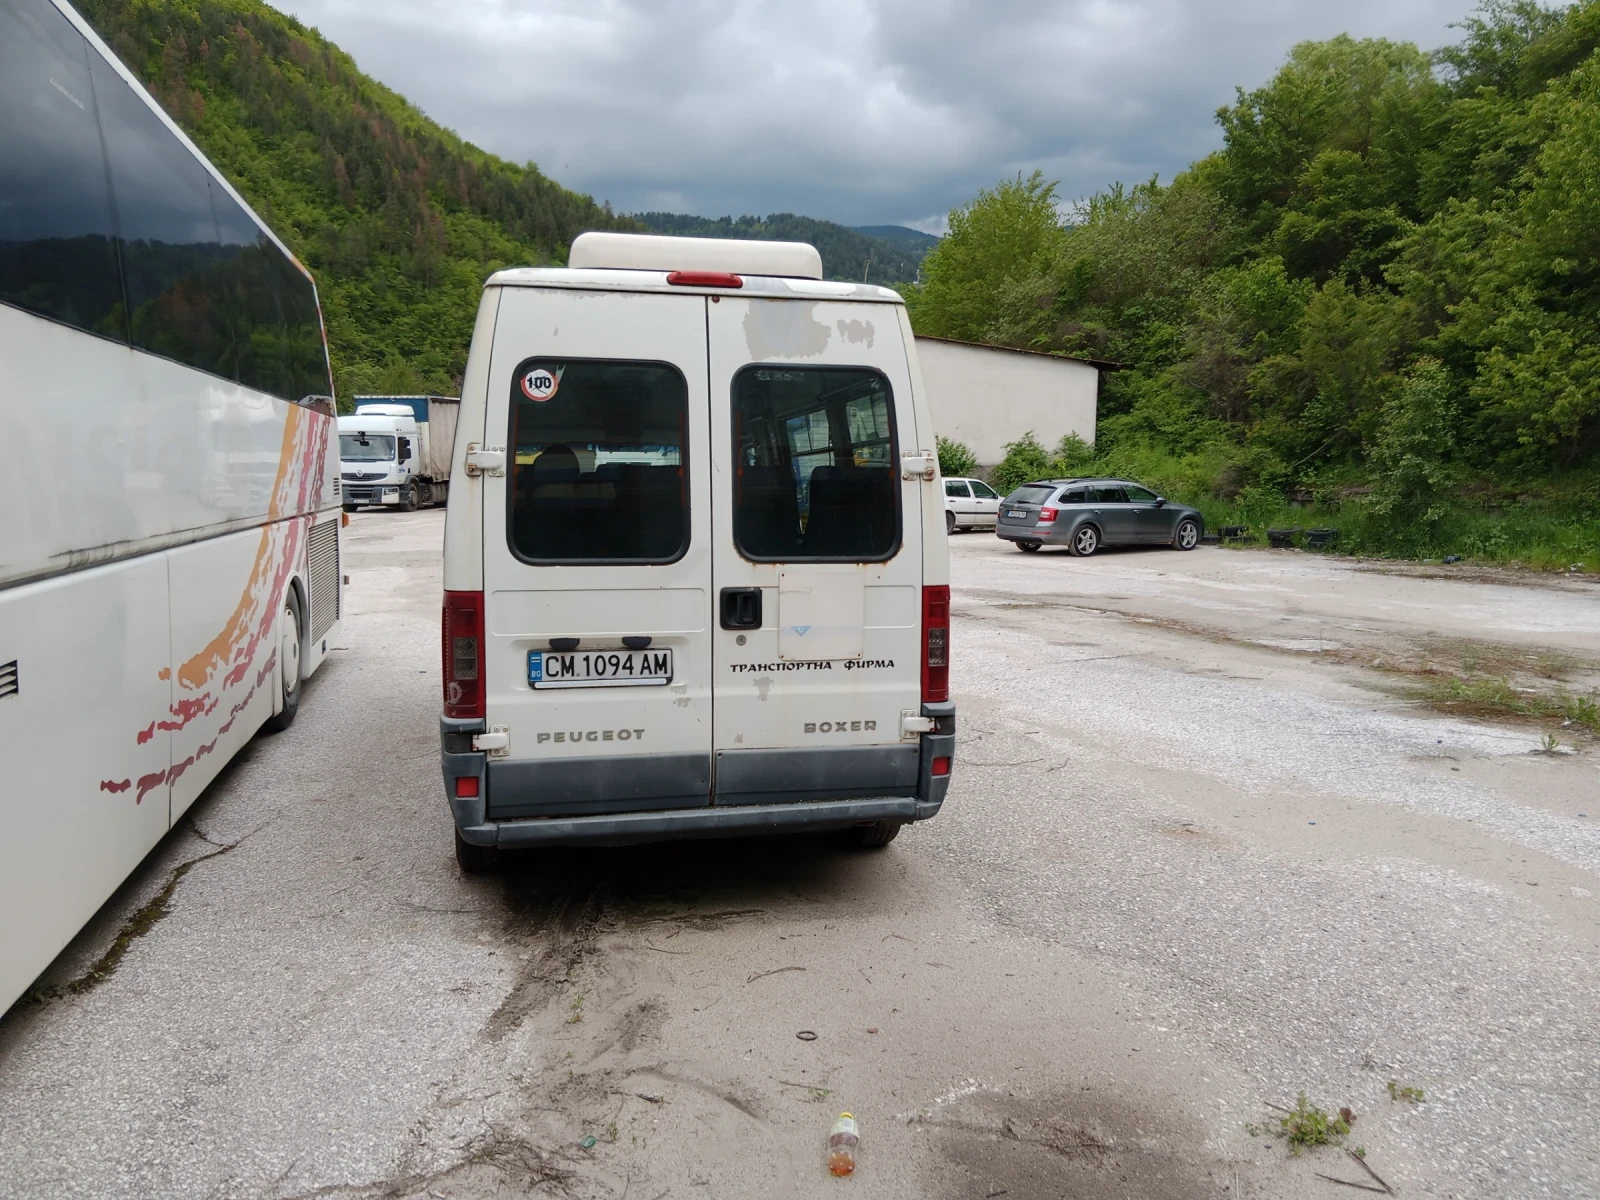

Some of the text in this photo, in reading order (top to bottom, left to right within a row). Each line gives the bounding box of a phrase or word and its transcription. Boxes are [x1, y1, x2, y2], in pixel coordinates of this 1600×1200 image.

[527, 376, 552, 389] 100
[545, 653, 668, 677] CM 1094 AM
[730, 661, 832, 673] ТРАНСПОРТНА
[531, 670, 541, 678] BG
[804, 720, 877, 734] BOXER
[537, 729, 646, 744] PEUGEOT
